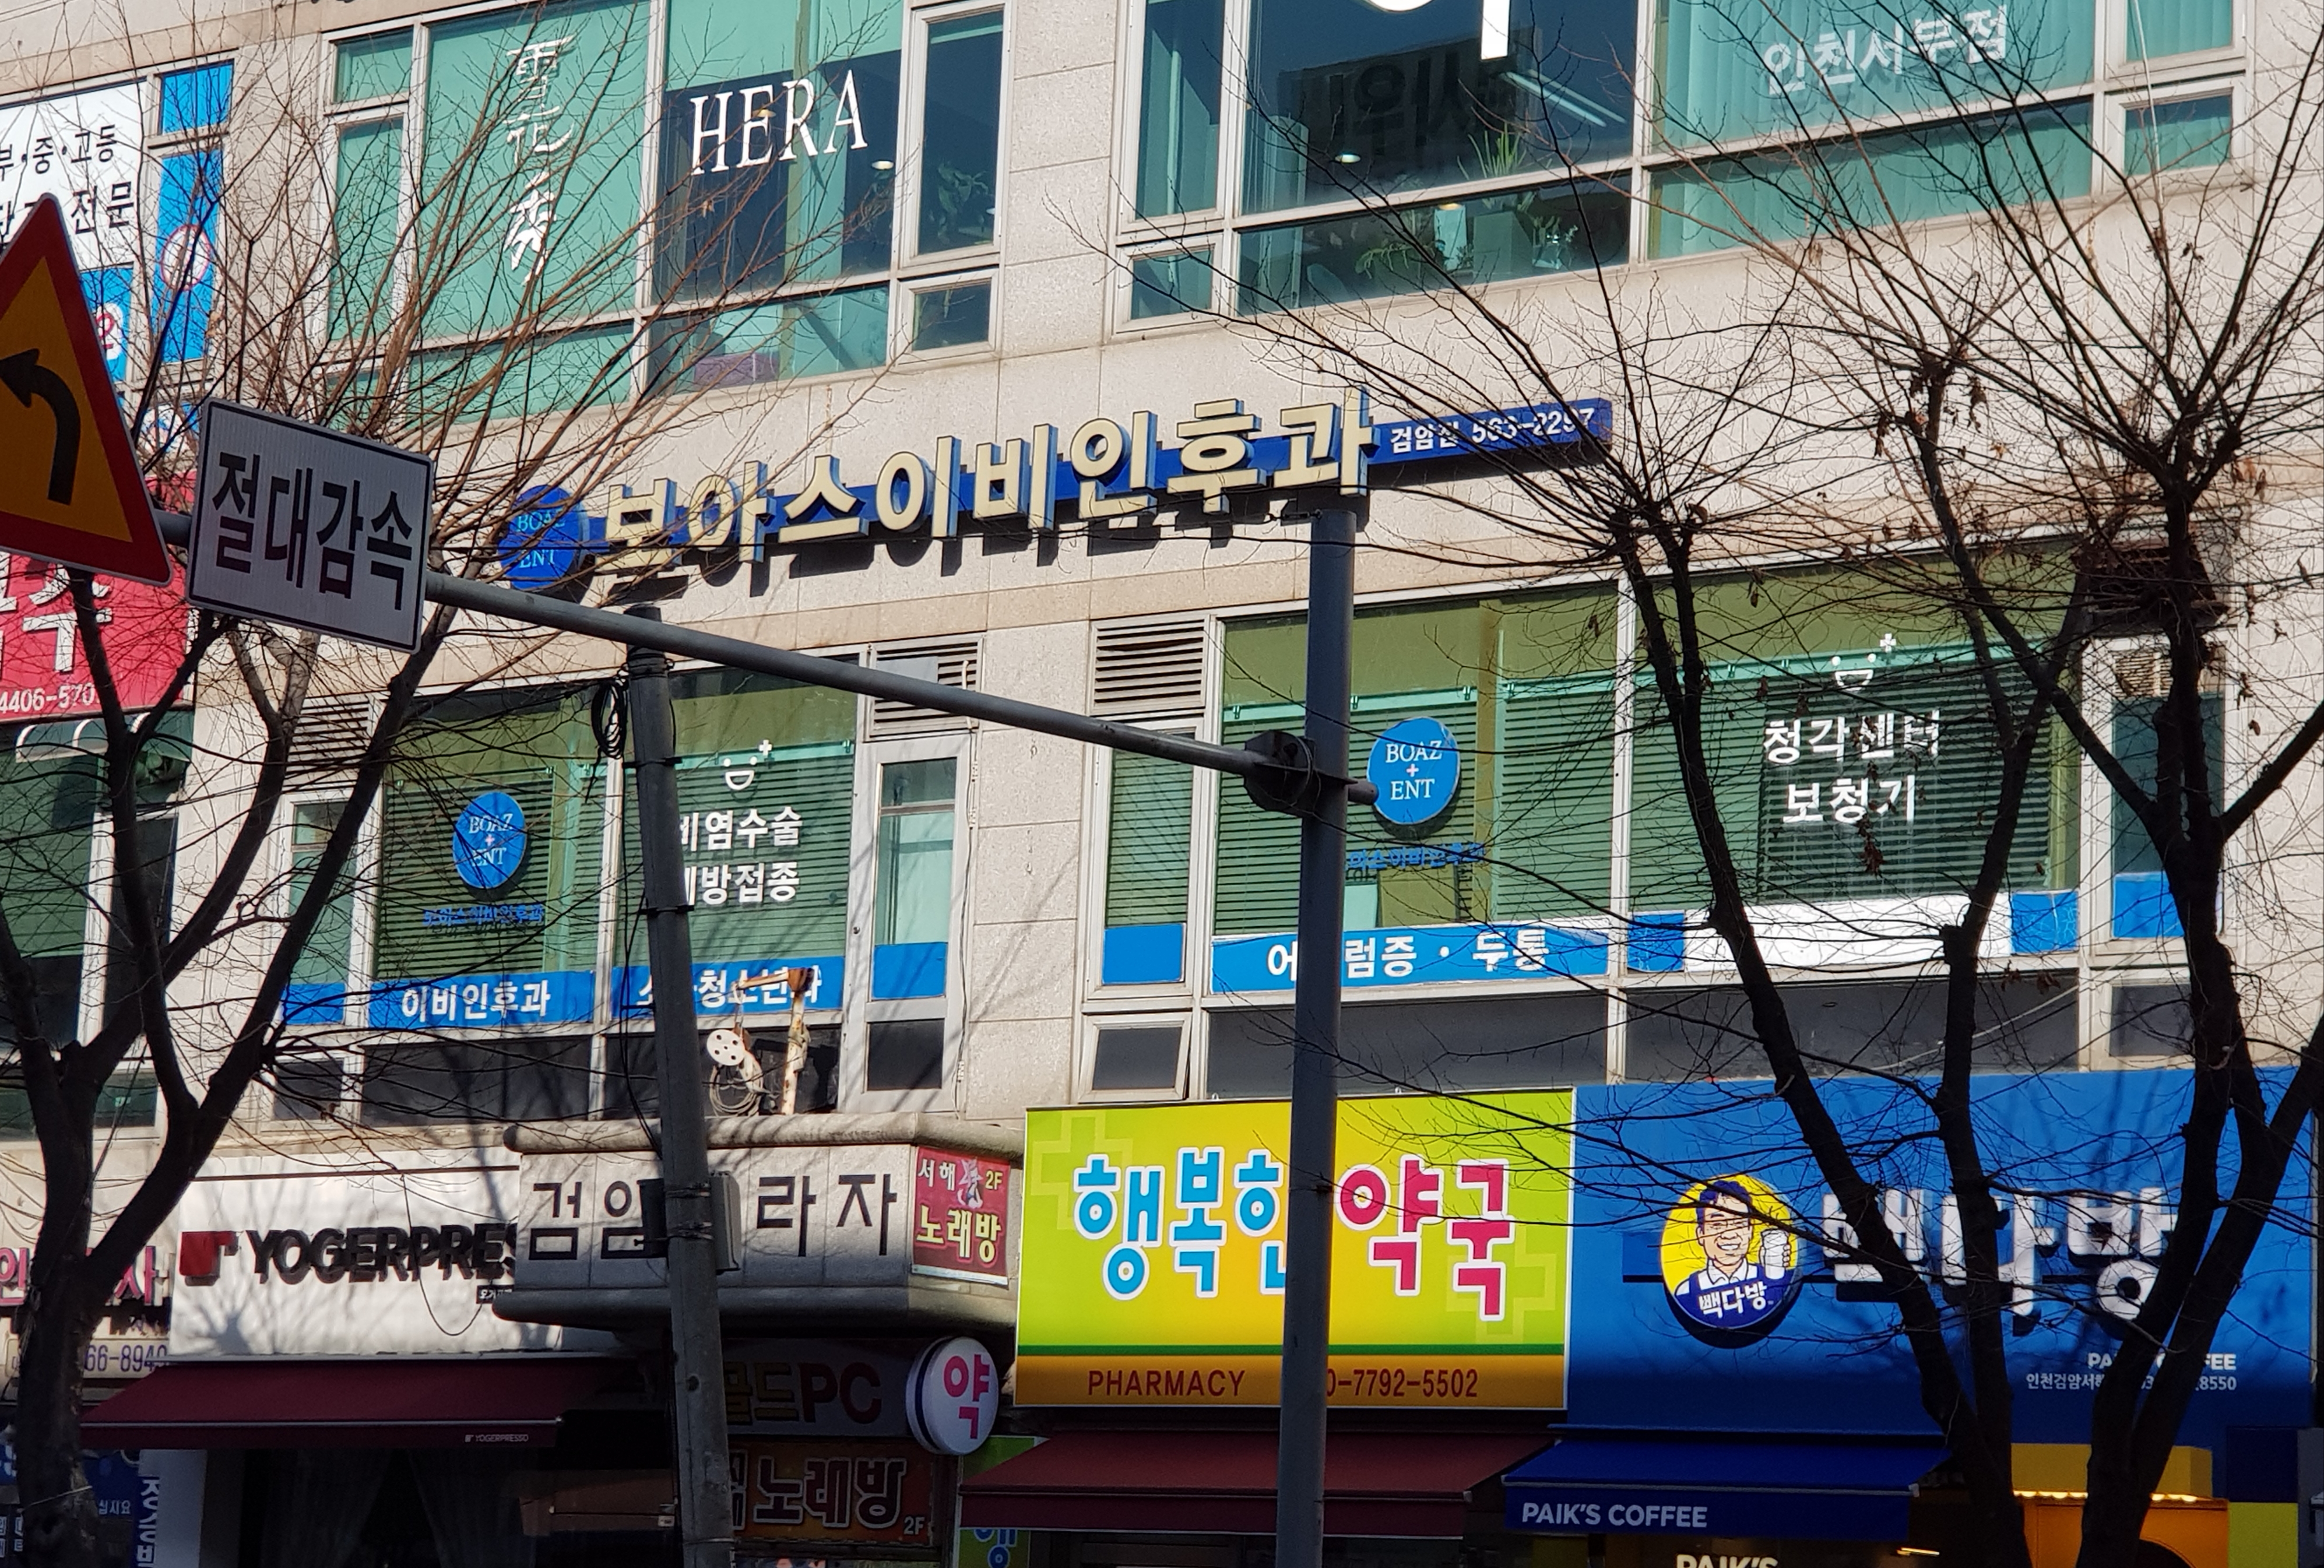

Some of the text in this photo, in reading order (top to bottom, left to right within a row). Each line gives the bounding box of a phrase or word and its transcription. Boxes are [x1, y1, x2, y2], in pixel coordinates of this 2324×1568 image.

[690, 69, 869, 175] HERA
[71, 181, 135, 234] 전문
[212, 451, 413, 611] 절대감속
[0, 683, 100, 714] 4406-570
[1385, 740, 1443, 764] BOAZ
[1390, 777, 1435, 801] ENT
[1782, 775, 1915, 824] 보청기
[469, 813, 514, 834] BOAZ
[472, 847, 507, 867] ENT
[1267, 929, 1549, 982] 어럼증 두통
[402, 979, 551, 1023] 이비인후과
[918, 1159, 1003, 1191] 서해 2F
[529, 1173, 898, 1260] 검암라자
[916, 1204, 1002, 1263] 노래방
[1335, 1154, 1516, 1321] 약국
[1698, 1281, 1767, 1319] 빽다방
[944, 1354, 990, 1440] 약
[1088, 1369, 1245, 1397] PHARMACY
[753, 1456, 908, 1530] 노래방
[1522, 1502, 1708, 1528] PAIK'S COFFEE
[903, 1516, 926, 1536] 2F
